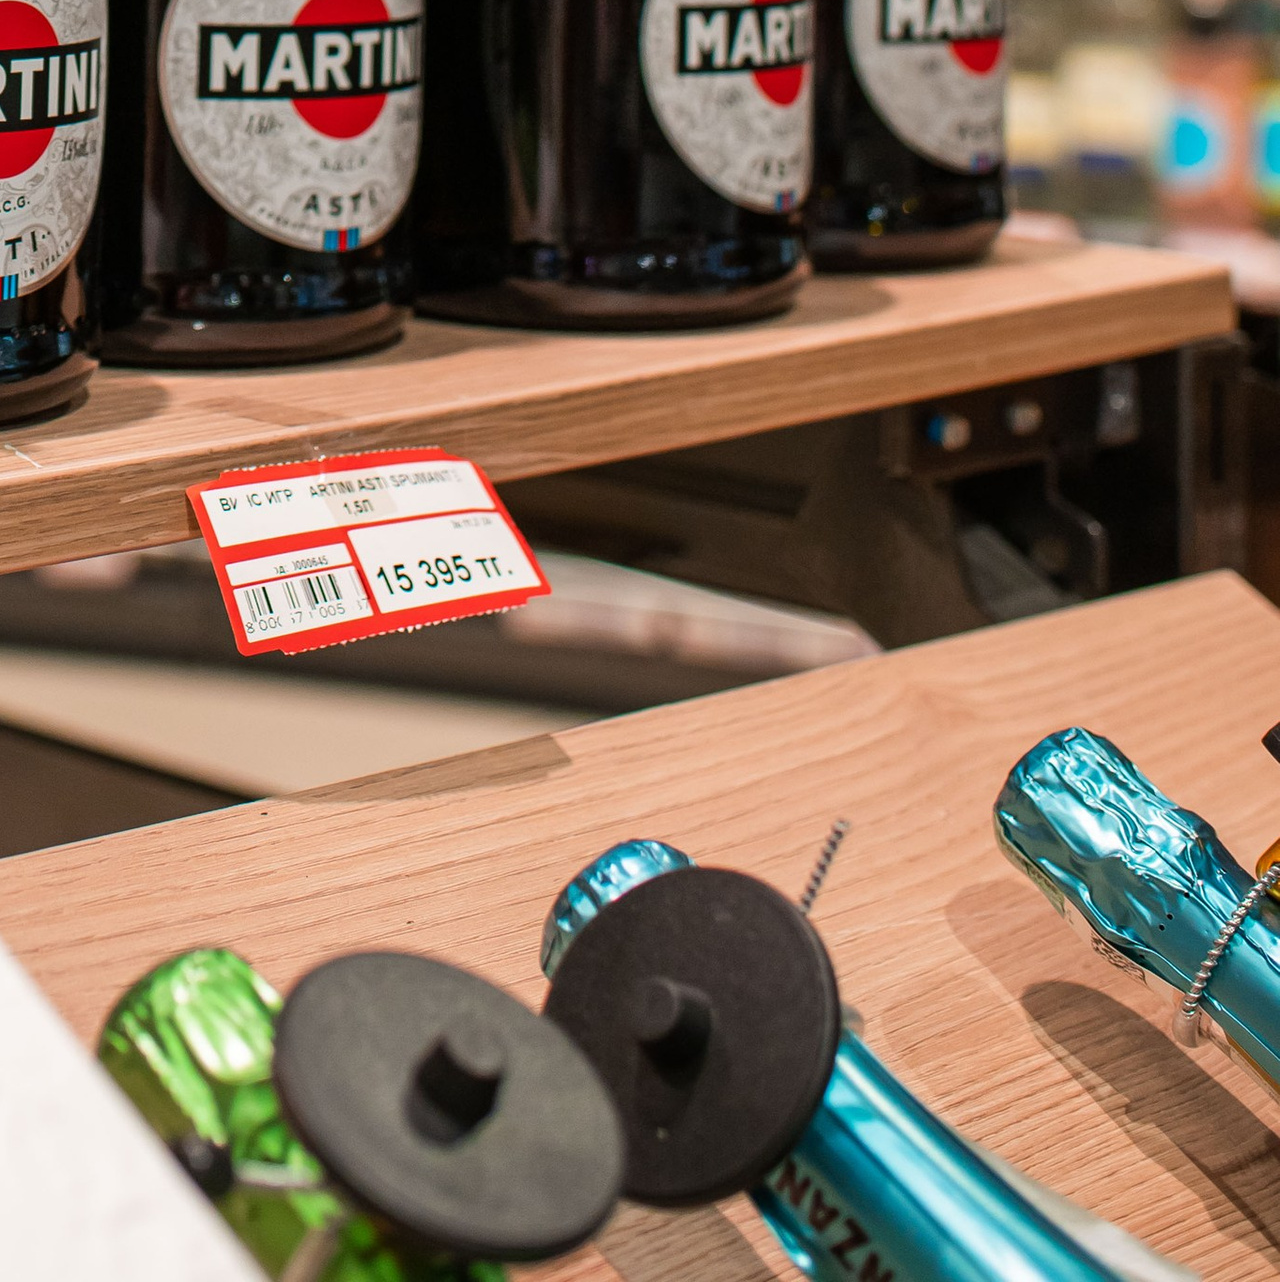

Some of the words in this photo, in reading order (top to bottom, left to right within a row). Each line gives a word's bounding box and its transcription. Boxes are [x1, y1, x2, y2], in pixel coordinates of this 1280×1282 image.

[308, 479, 357, 498] ARTINI
[376, 563, 414, 596] 15
[418, 554, 471, 588] 395
